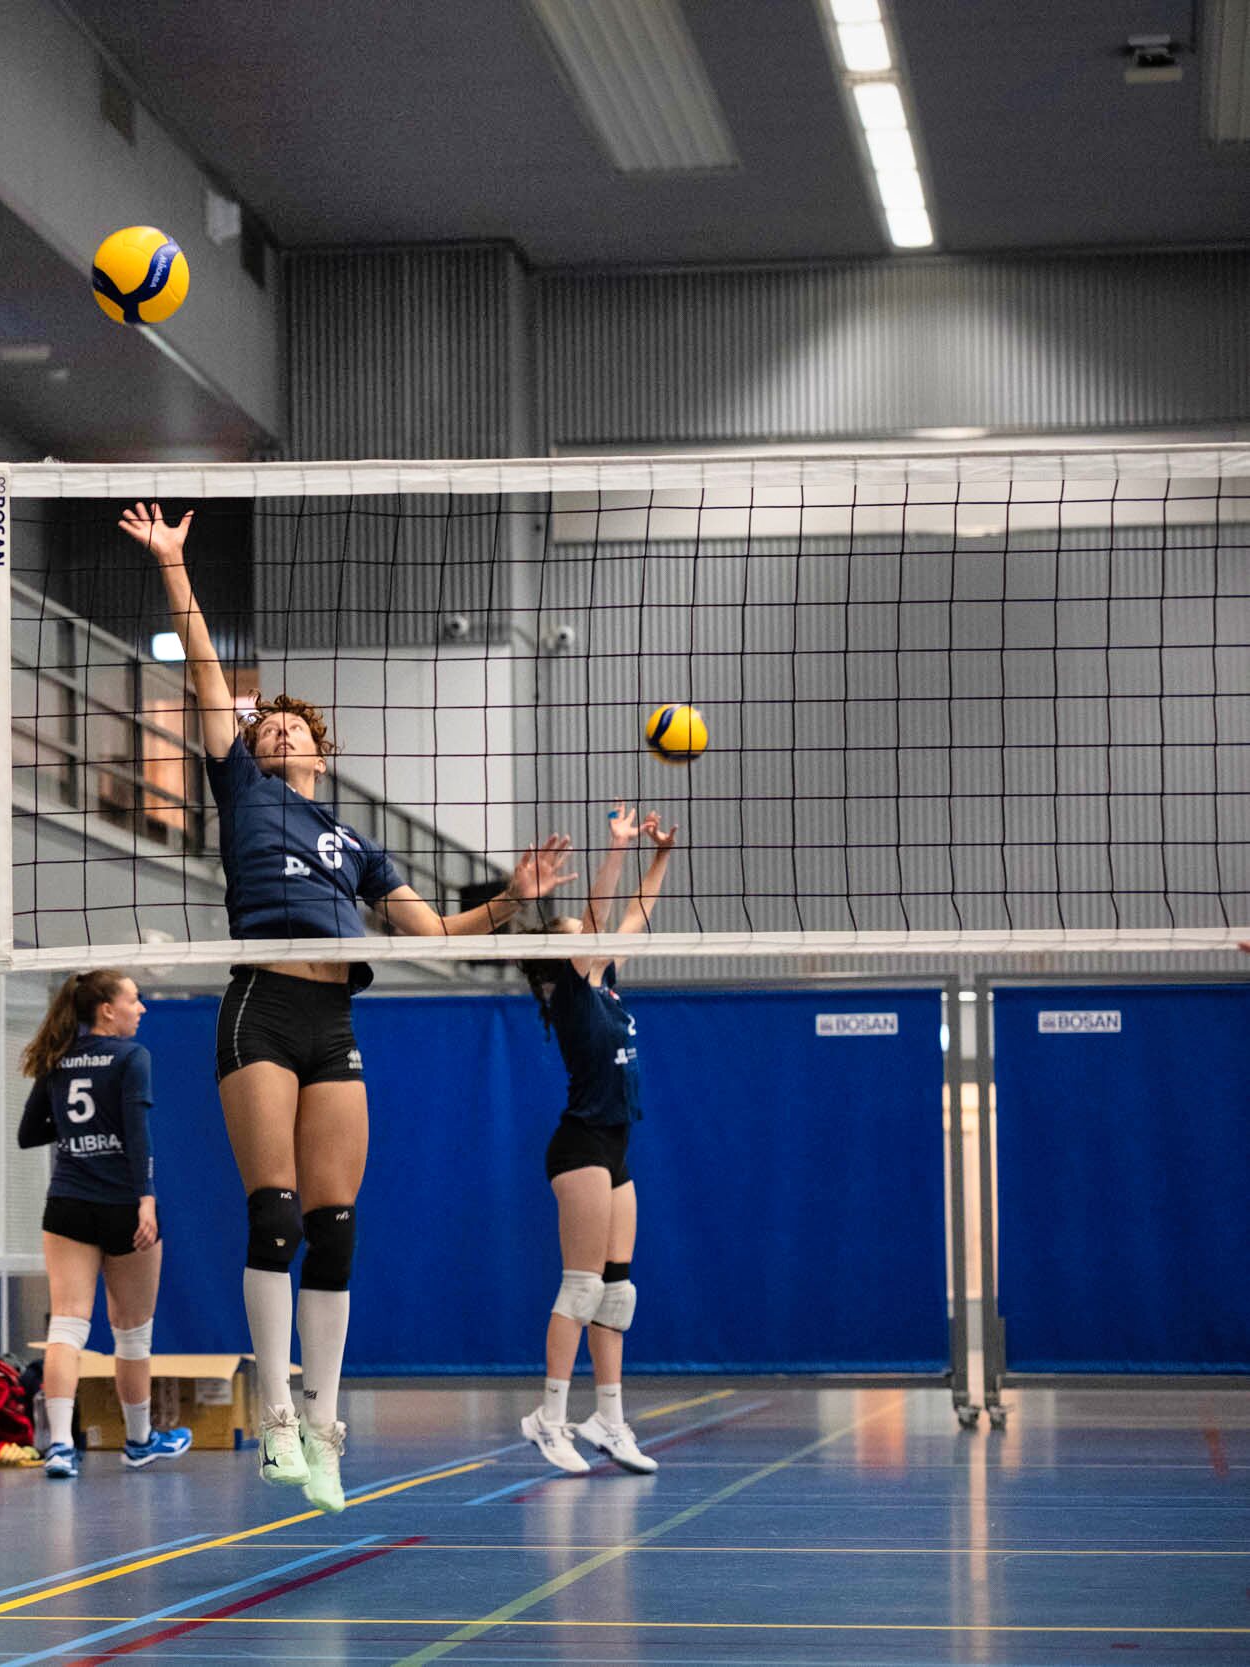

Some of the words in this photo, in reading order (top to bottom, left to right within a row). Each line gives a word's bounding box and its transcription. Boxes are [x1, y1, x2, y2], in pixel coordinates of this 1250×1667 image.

[317, 832, 343, 870] 6
[835, 1017, 895, 1032] BOSAN
[1058, 1014, 1119, 1030] BOSAN
[67, 1078, 95, 1124] 5
[70, 1134, 123, 1153] LIBRA
